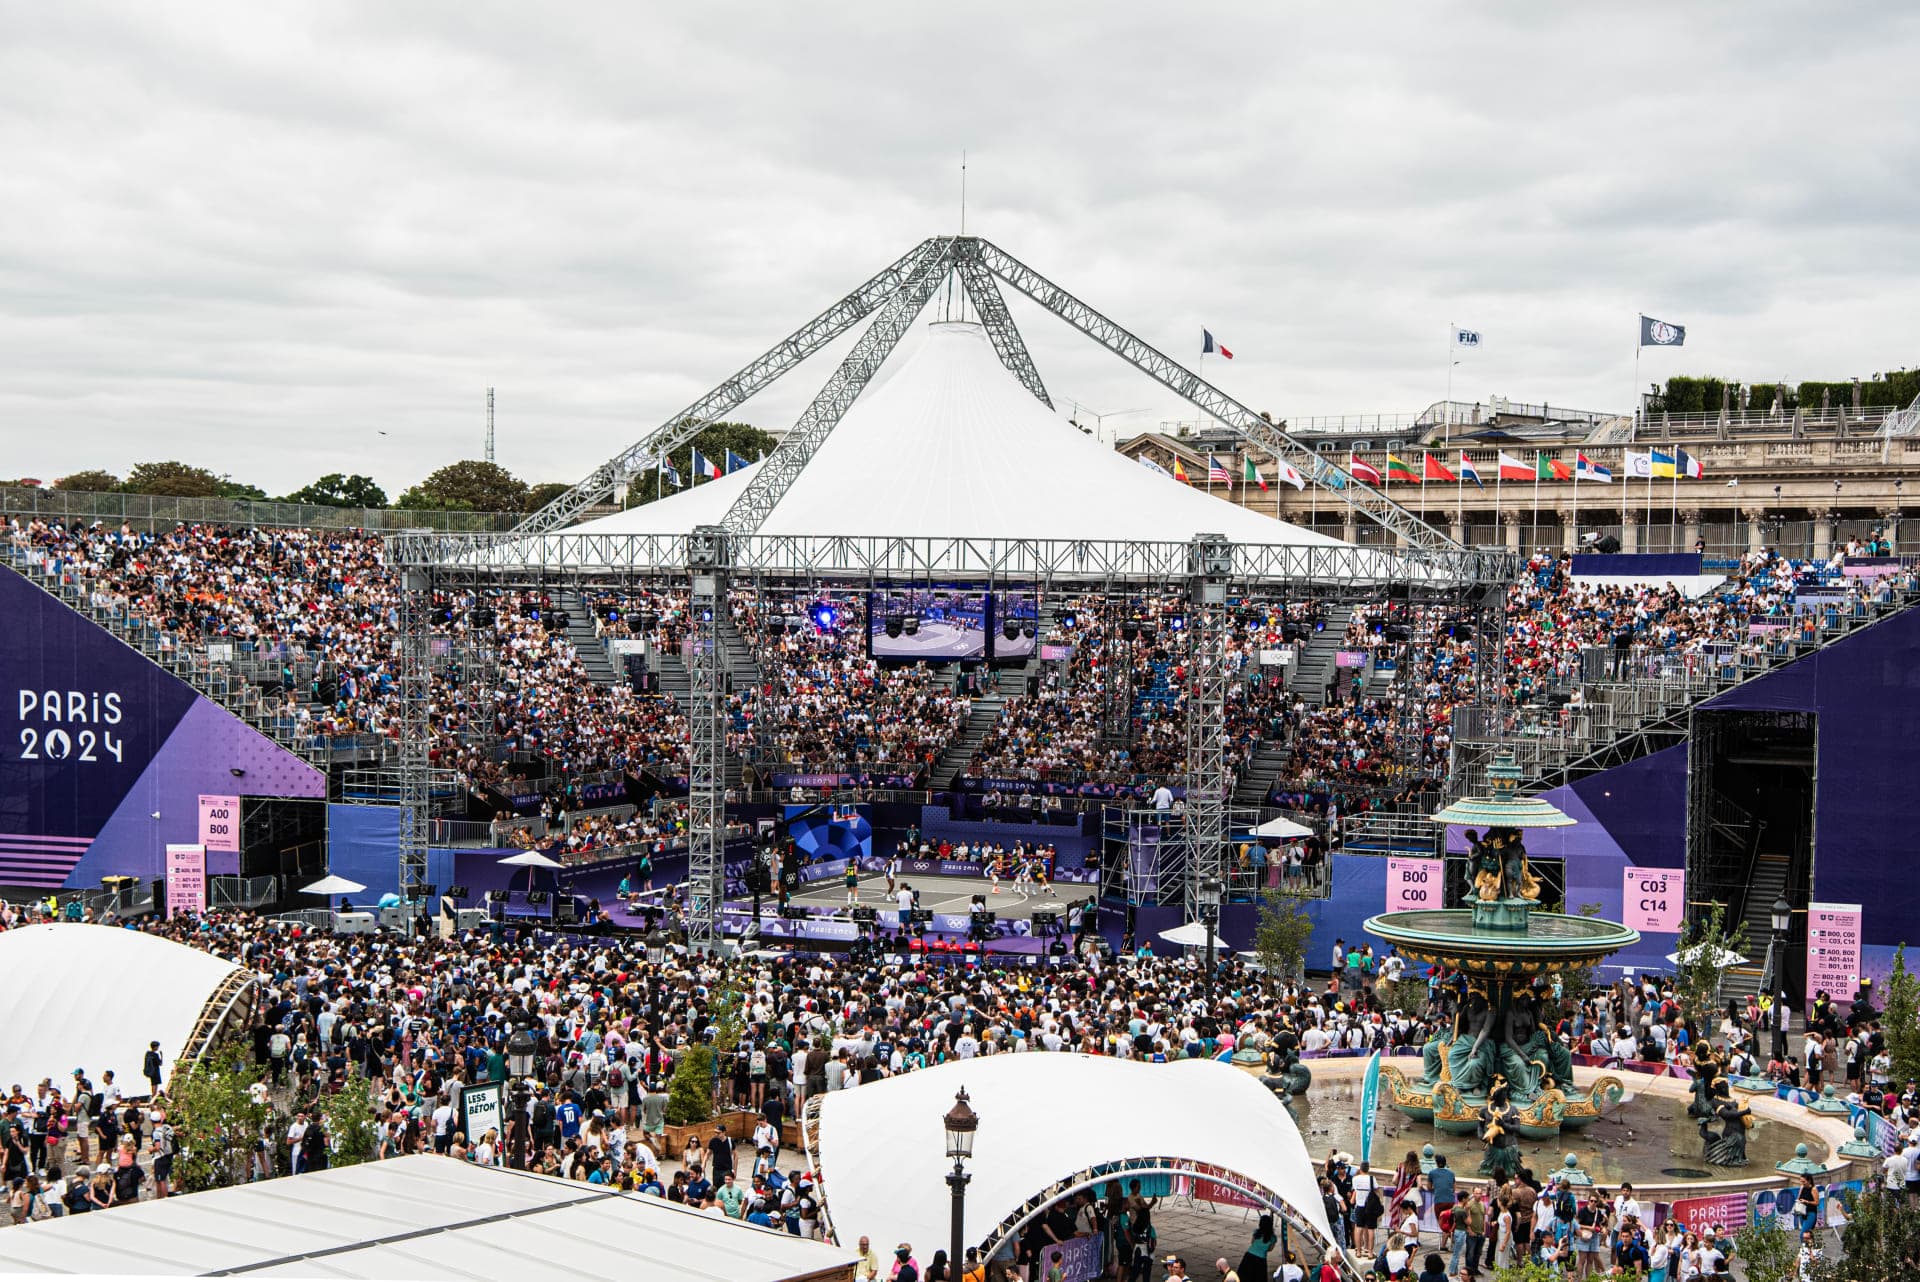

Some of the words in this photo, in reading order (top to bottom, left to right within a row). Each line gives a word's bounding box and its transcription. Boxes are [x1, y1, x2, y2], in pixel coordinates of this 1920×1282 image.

[1459, 332, 1478, 343] FIA
[20, 727, 122, 763] 2024
[210, 808, 229, 819] A00
[210, 824, 228, 834] B00
[1402, 871, 1428, 882] B00
[1640, 880, 1667, 893] C03
[1402, 889, 1427, 902] C00
[1640, 900, 1667, 912] C14
[468, 1092, 486, 1104] LESS
[469, 1101, 495, 1114] BÉTON
[564, 1110, 574, 1124] 10
